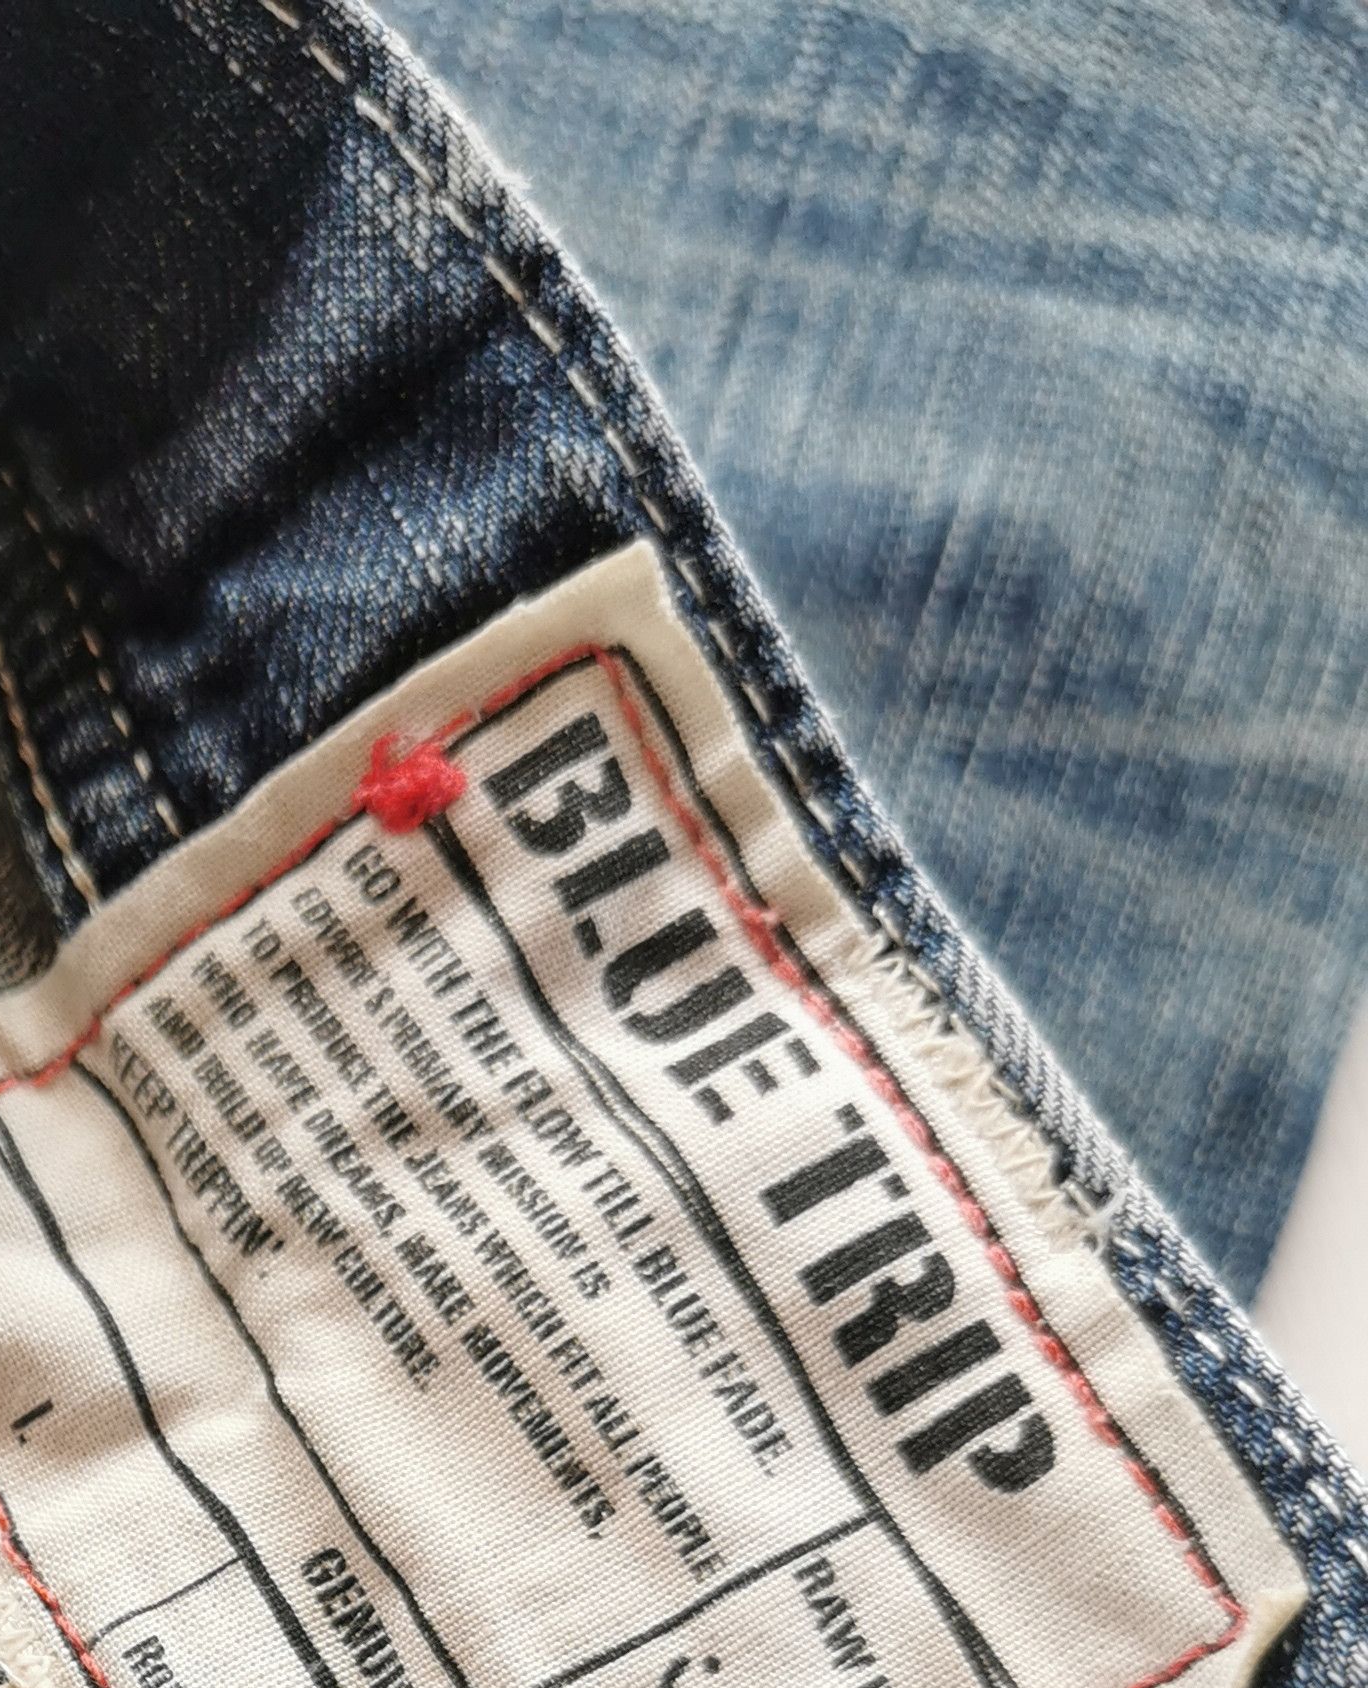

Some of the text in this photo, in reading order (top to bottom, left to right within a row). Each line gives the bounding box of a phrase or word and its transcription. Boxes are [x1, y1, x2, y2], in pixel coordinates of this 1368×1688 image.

[106, 1033, 178, 1123] KEEP
[145, 995, 444, 1392] AND BUILD UP NEW CULTURE.
[192, 953, 617, 1539] WHO HAVE DREAMS, MAKE MOVEMENTS,
[240, 915, 726, 1583] TO PRODUCE THE JEANS WHICH FIT ALL PEOPLE
[291, 886, 612, 1301] EDWIN'S PRIMARY MISSION IS
[343, 843, 794, 1478] GO WITH THE FLOW TILL BLUE FADE.
[480, 708, 1057, 1496] BLUE TRIP
[794, 1556, 878, 1673] RAW
